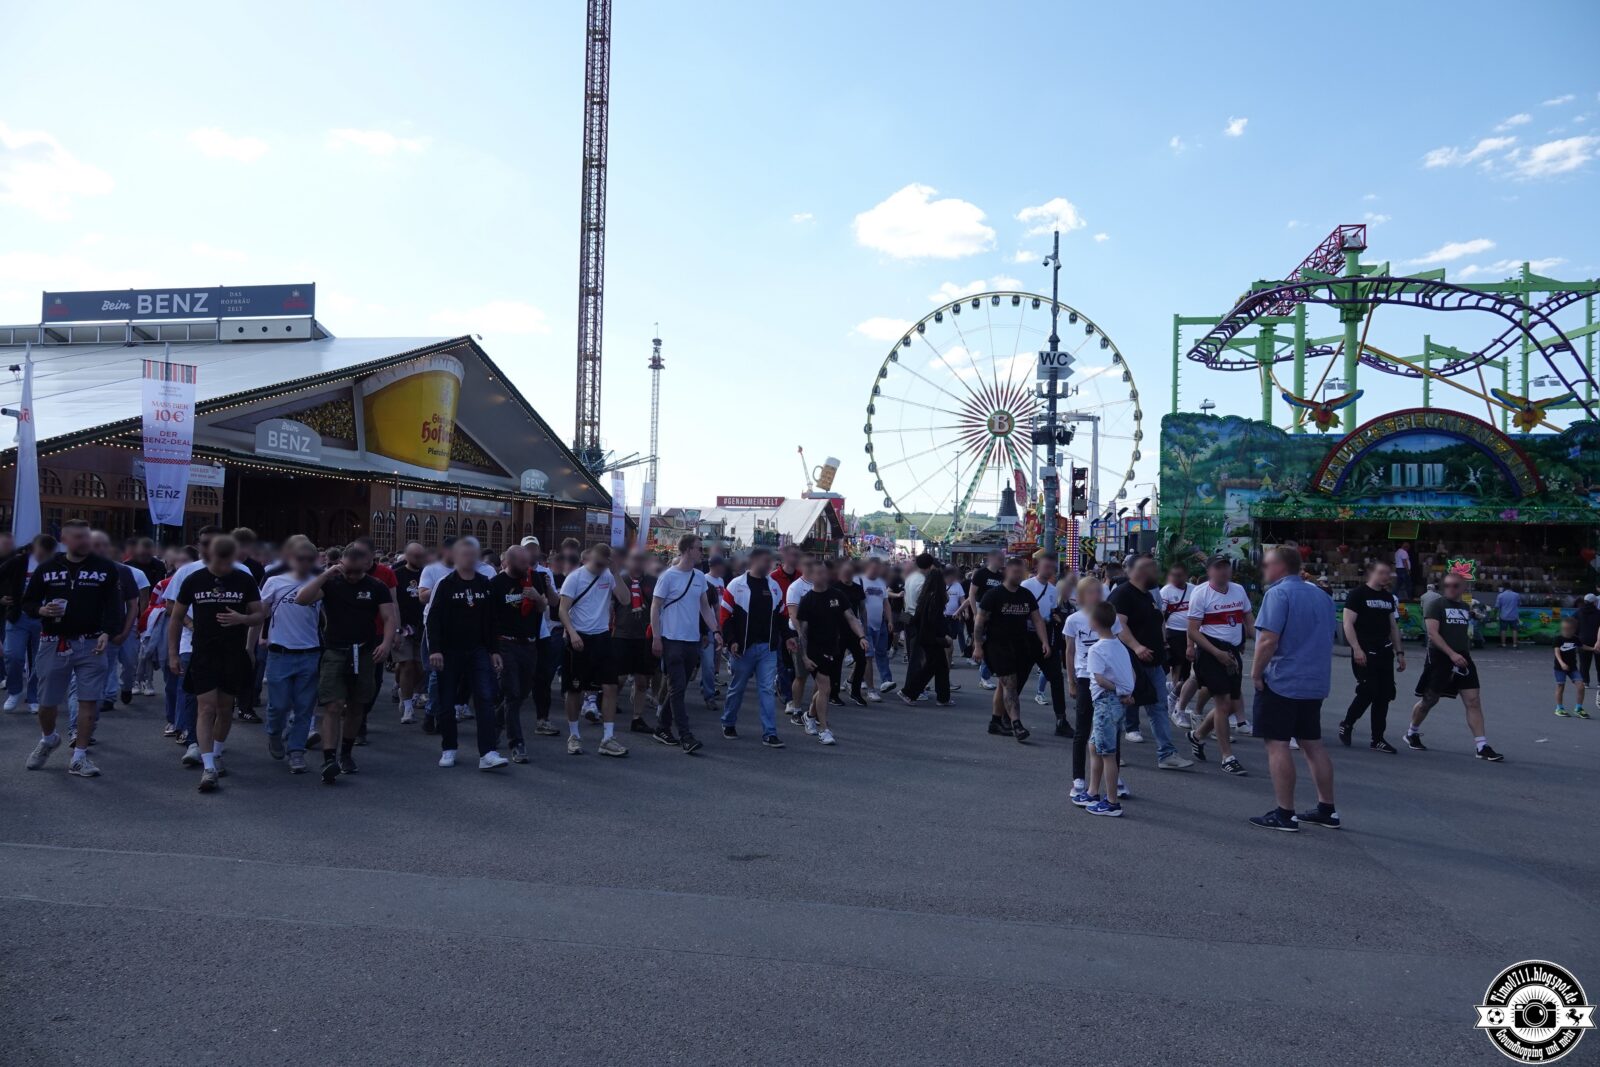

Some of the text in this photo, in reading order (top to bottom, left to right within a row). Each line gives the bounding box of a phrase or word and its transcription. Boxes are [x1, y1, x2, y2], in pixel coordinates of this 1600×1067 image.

[101, 293, 209, 314] Beim BENZ
[1039, 352, 1069, 367] WC
[155, 409, 185, 422] 10€
[992, 414, 1009, 431] B
[144, 436, 192, 446] BENZ-DEAL
[160, 430, 178, 438] DER
[268, 430, 311, 453] BENZ
[525, 477, 545, 491] BENZ
[445, 498, 471, 512] BENZ
